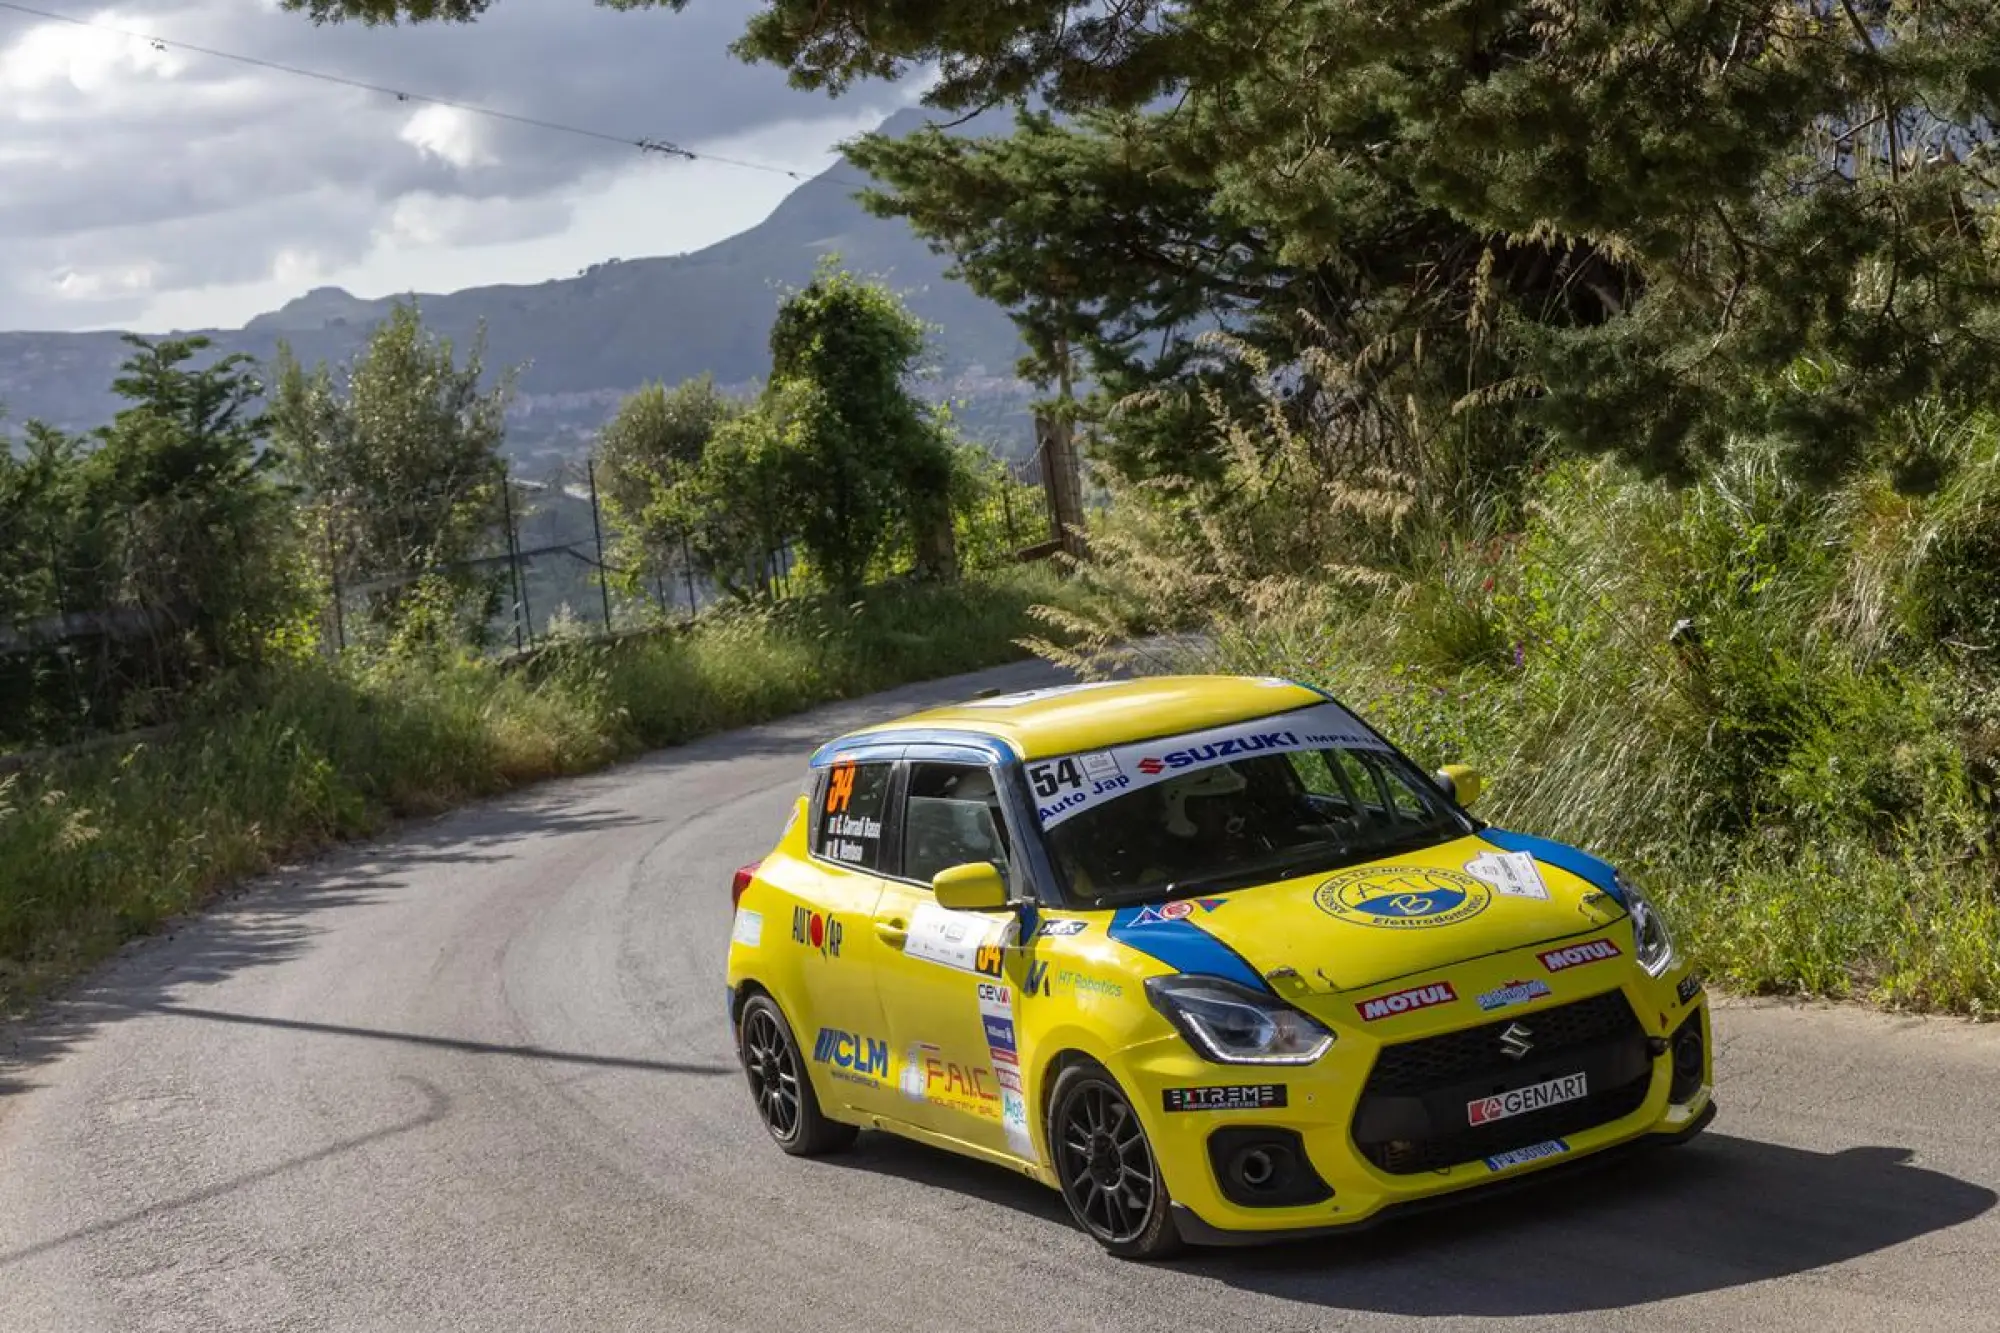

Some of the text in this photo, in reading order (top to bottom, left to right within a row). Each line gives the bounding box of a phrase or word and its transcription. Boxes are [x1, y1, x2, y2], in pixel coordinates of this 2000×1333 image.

[1165, 731, 1300, 769] SUZUKI
[1029, 757, 1082, 797] 54
[1038, 774, 1130, 821] Auto Jap
[1544, 939, 1619, 970] MOTUL
[1075, 973, 1122, 997] Robotics
[1364, 983, 1452, 1019] MOTUL
[834, 1030, 888, 1078] CLM
[1172, 1085, 1273, 1104] ETREME
